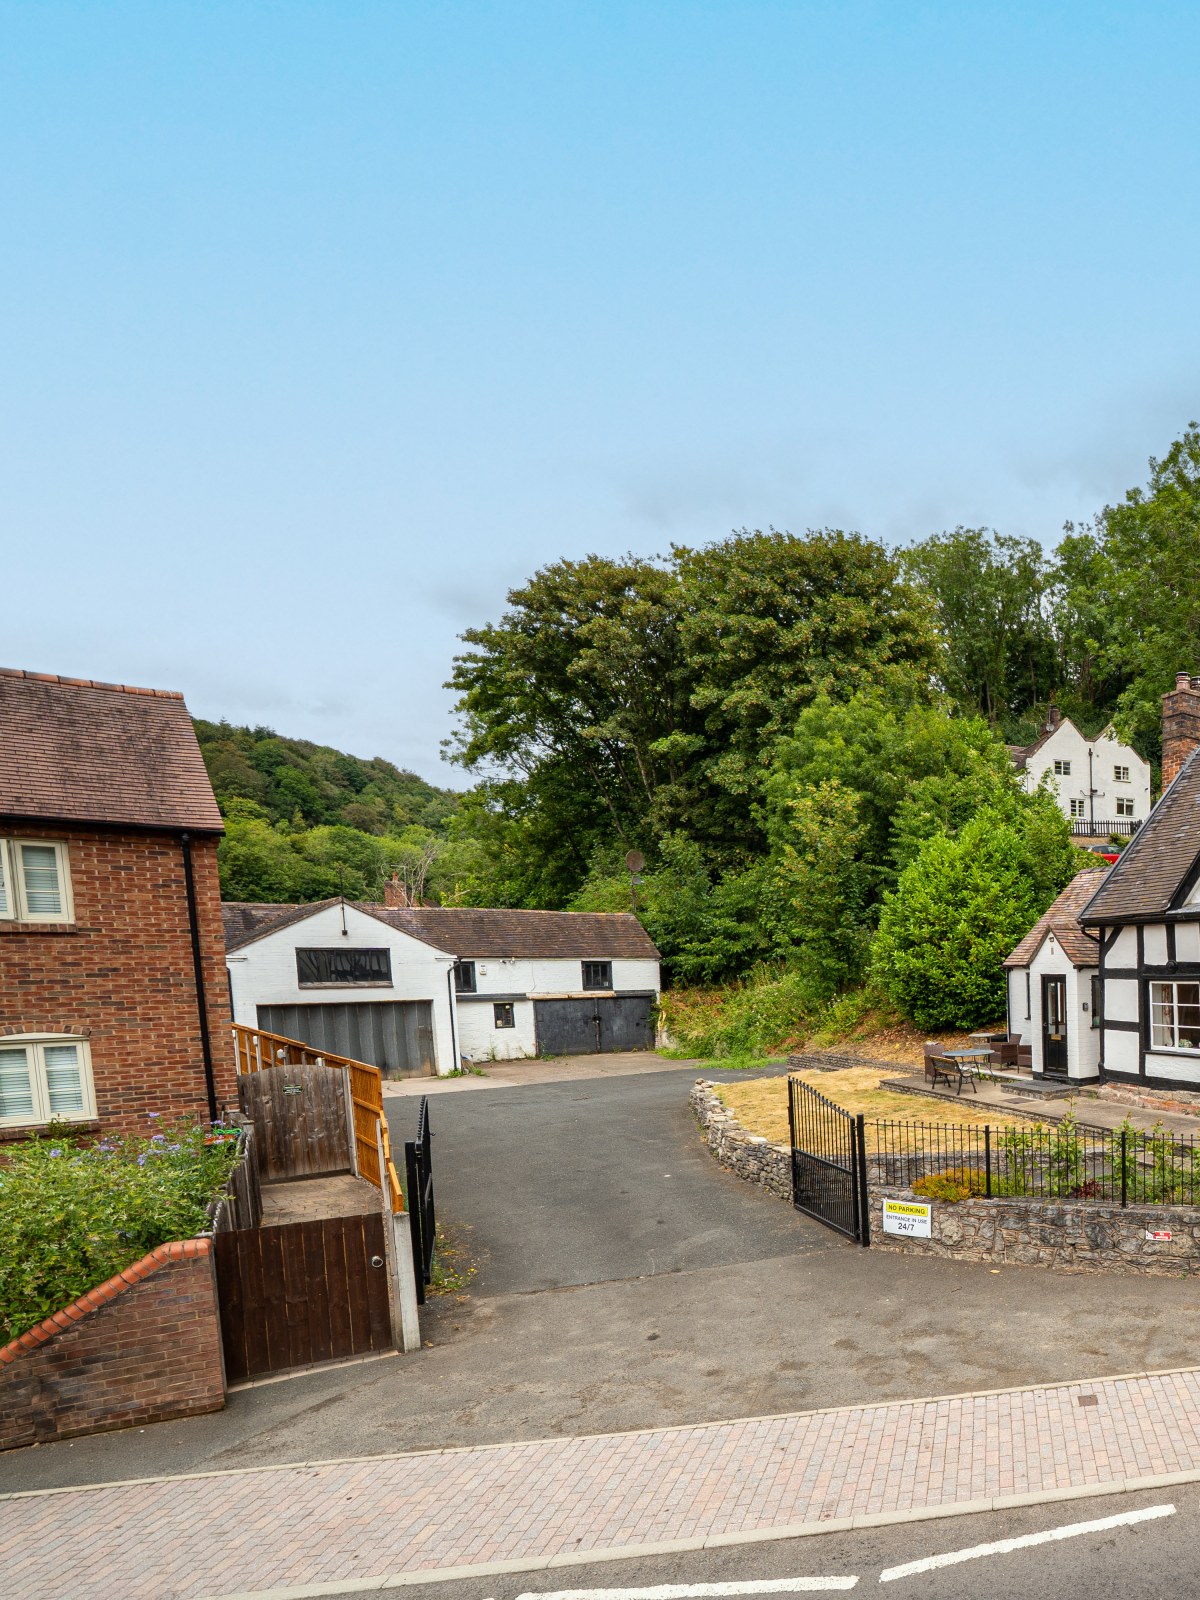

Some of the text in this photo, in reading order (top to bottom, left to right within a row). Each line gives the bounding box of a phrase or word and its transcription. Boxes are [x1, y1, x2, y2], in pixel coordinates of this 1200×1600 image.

[898, 1205, 925, 1214] PARKING
[886, 1214, 911, 1223] ENTRANCE
[897, 1222, 915, 1231] 24/7
